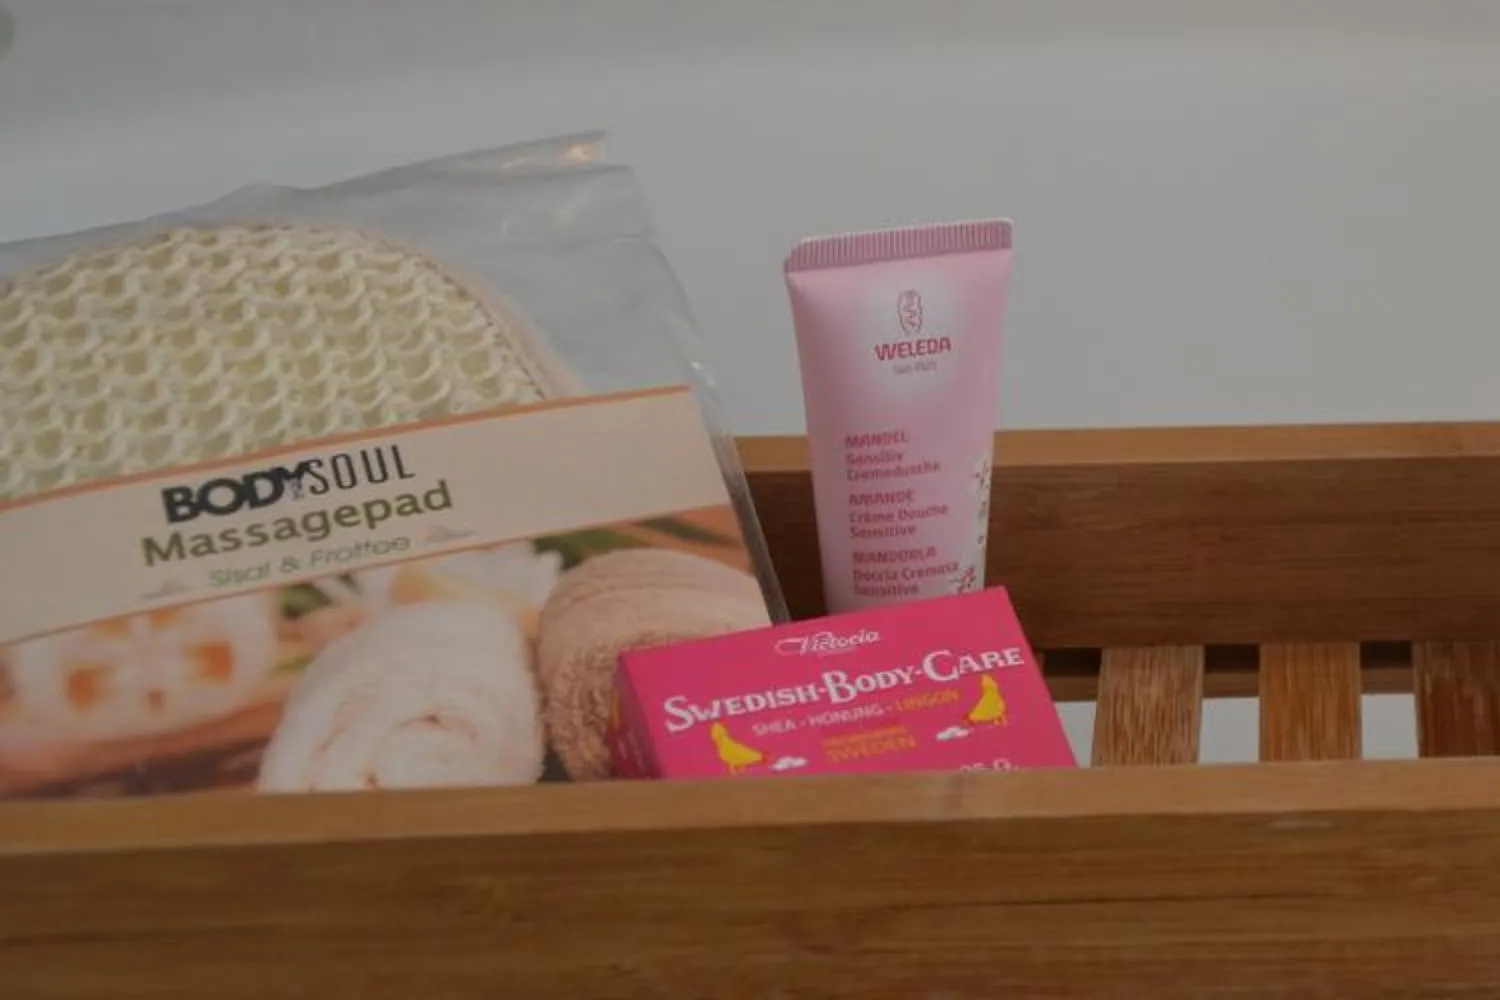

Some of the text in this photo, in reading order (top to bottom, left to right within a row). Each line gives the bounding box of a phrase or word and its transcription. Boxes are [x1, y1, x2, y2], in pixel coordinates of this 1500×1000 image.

[874, 336, 951, 361] WELEDA
[140, 480, 453, 567] Massagepad
[279, 555, 300, 574] &
[752, 718, 798, 737] SHEA
